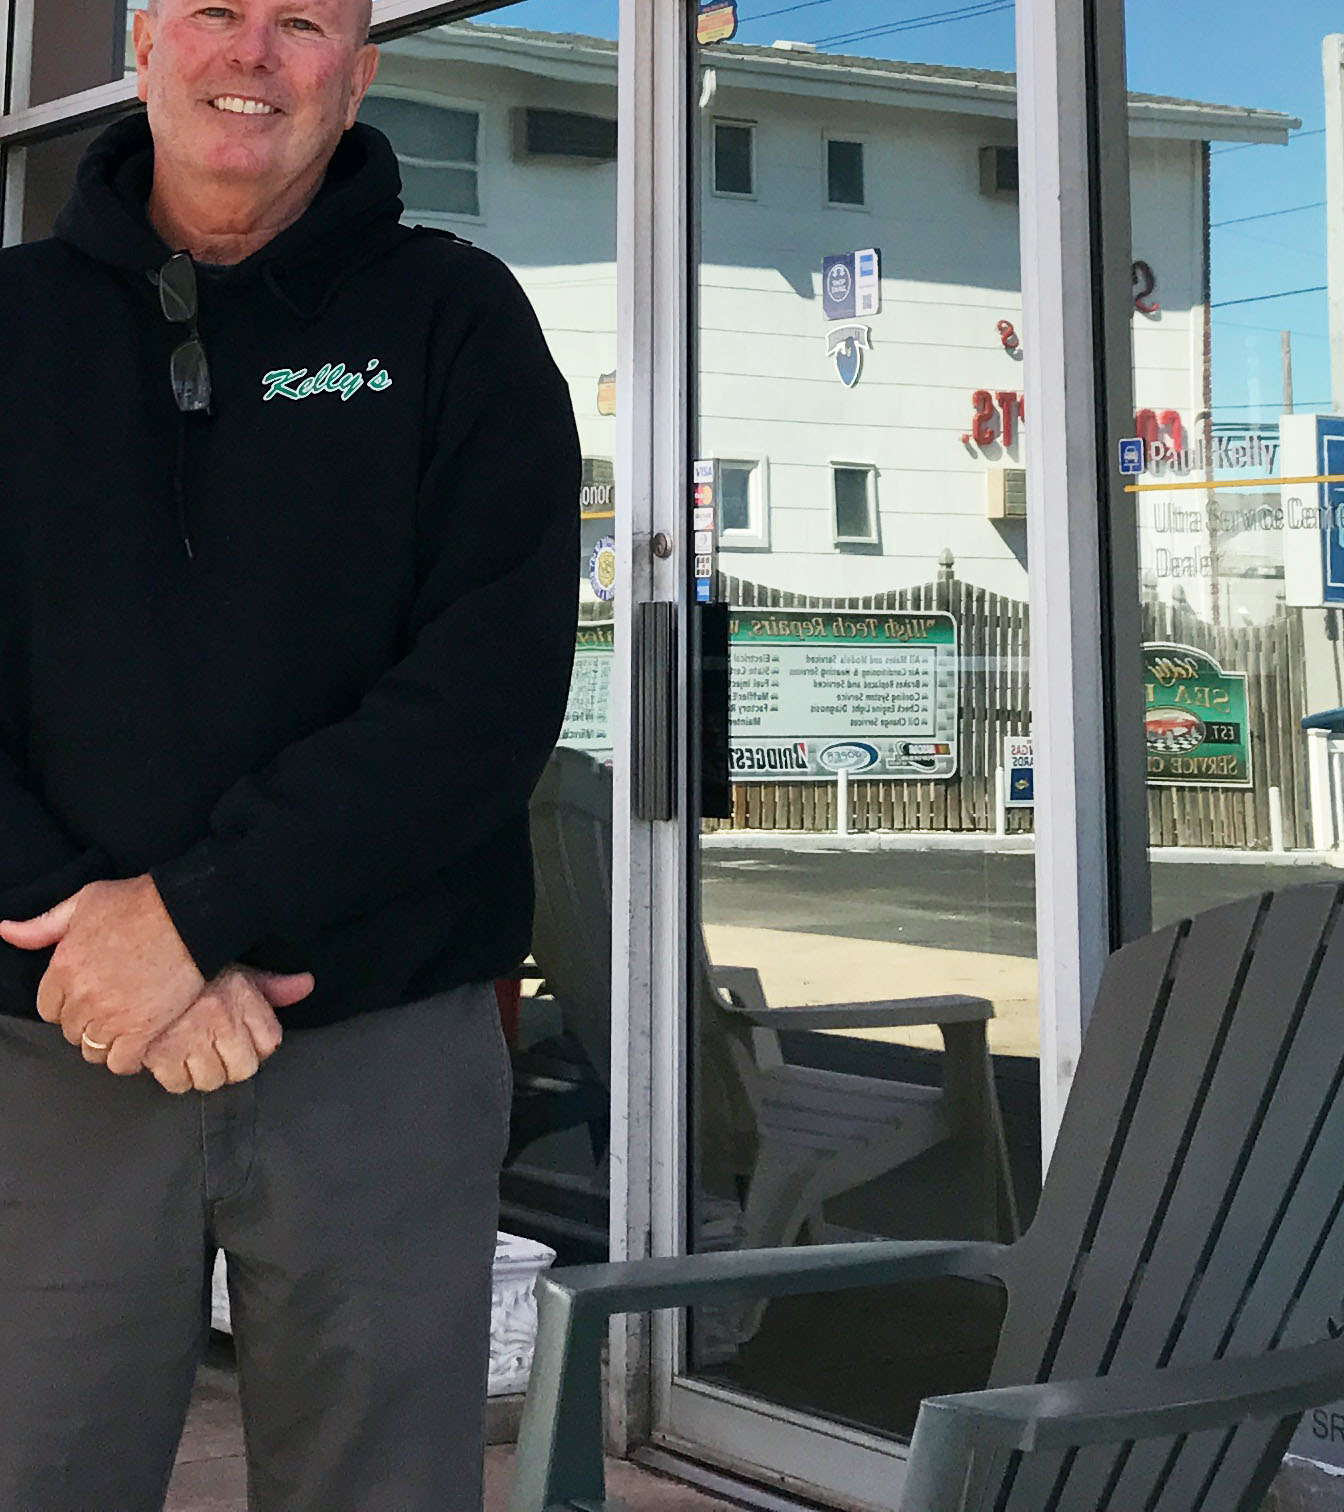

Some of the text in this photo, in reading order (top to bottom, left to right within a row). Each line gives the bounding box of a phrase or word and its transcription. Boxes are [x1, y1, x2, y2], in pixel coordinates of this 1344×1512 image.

[262, 359, 392, 401] Kelly's
[1150, 437, 1206, 472] Paul
[1212, 435, 1280, 475] Kelly
[582, 484, 613, 506] onor
[1153, 501, 1202, 533] Ultra
[1207, 498, 1285, 532] Service
